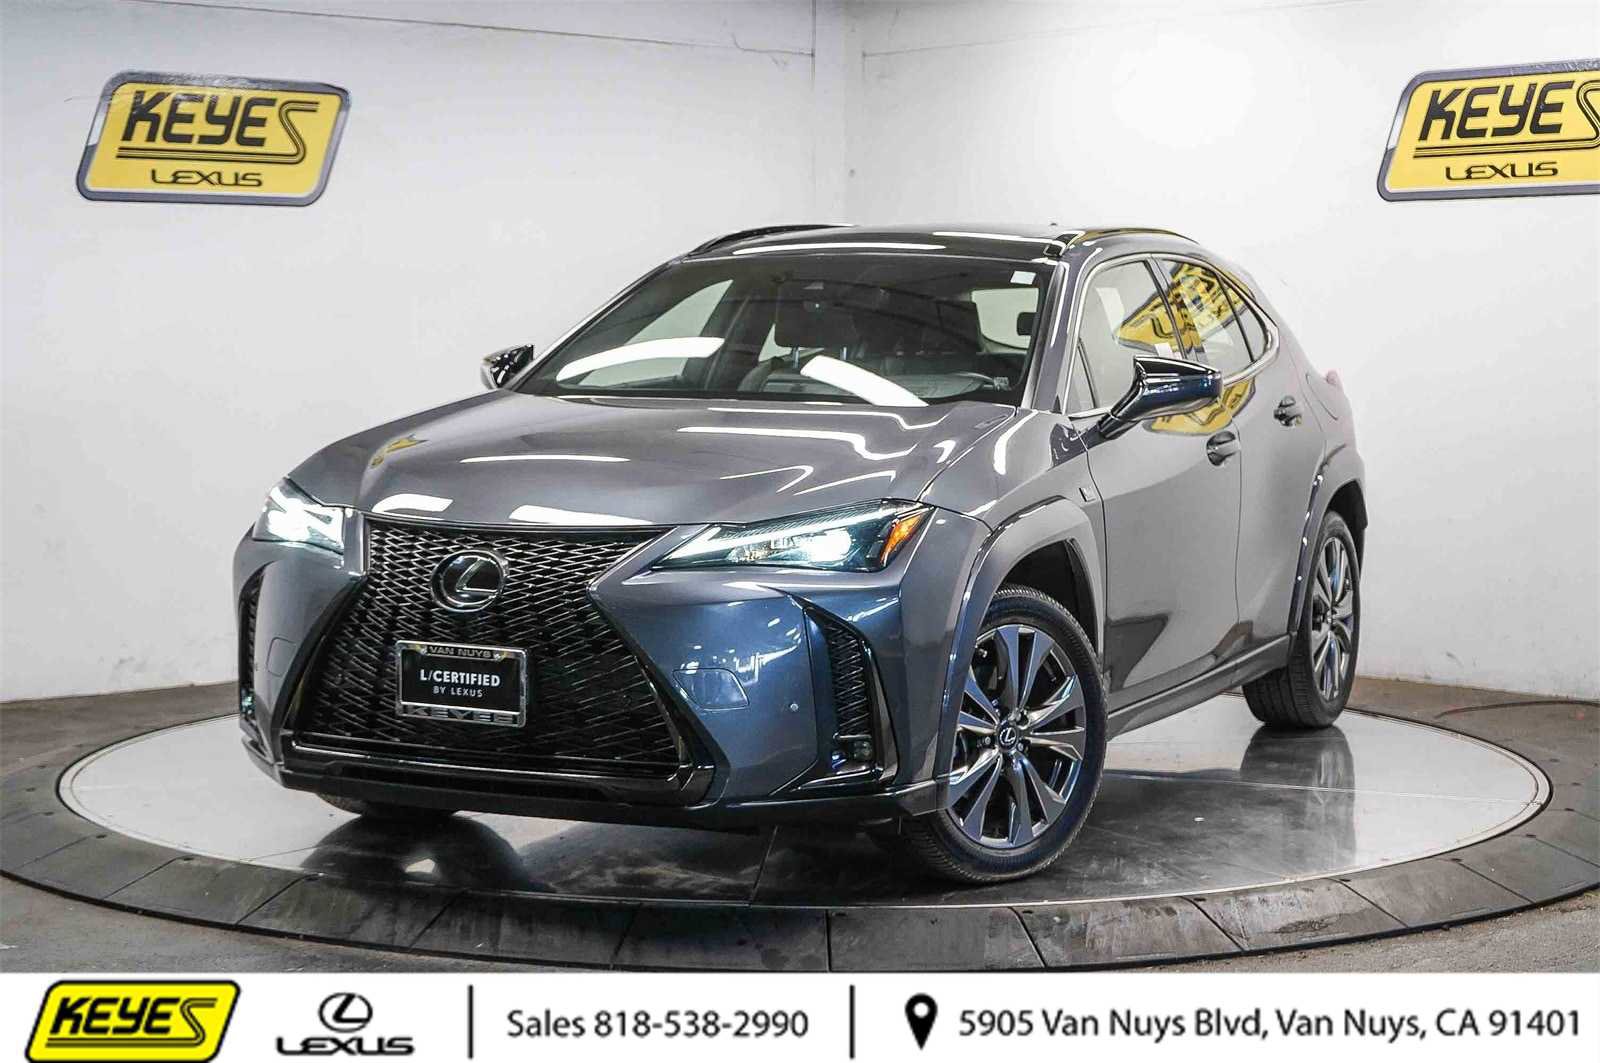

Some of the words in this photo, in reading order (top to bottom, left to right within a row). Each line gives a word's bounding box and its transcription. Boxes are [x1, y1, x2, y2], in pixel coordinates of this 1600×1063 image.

[117, 89, 319, 164] KEYES
[151, 169, 262, 187] LEXUS
[1445, 161, 1559, 180] LEXUS
[428, 645, 455, 655] VAN
[458, 649, 492, 658] NUYS
[420, 669, 501, 687] L/CERTIFIED
[433, 685, 447, 695] BY
[451, 687, 484, 698] LEXUS
